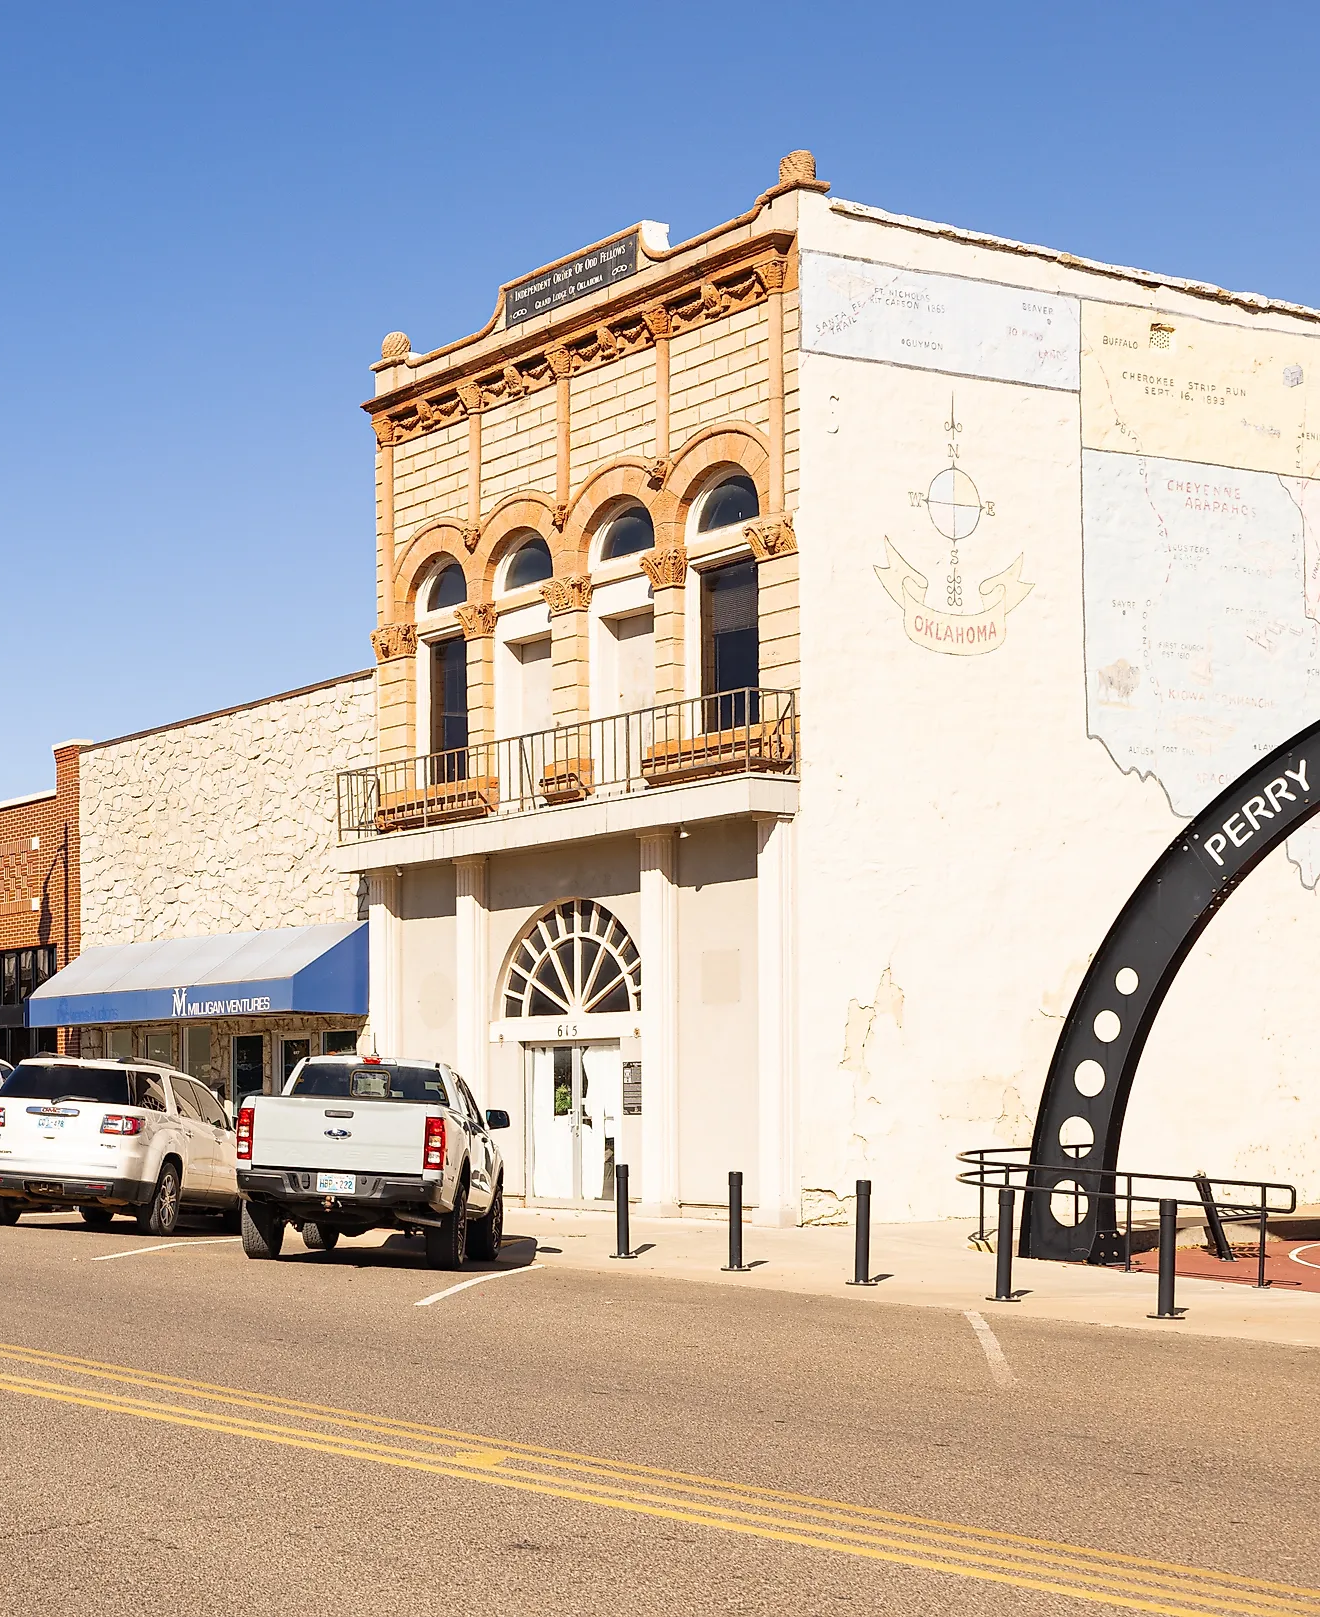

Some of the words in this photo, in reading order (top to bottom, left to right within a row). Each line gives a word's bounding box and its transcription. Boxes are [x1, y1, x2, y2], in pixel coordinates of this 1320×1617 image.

[515, 276, 551, 302] INDEPENDENT
[553, 269, 572, 284] ORDER
[575, 262, 583, 274] OF
[585, 256, 598, 271] ODD
[600, 244, 626, 265] FELLOWS
[535, 295, 552, 310] GRAND
[552, 290, 568, 304] LODGE
[1022, 302, 1054, 315] BEAVER
[906, 339, 944, 351] GUYMON
[1102, 335, 1139, 350] BUFFALO
[1122, 371, 1175, 387] CHEROKEE
[1188, 381, 1217, 393] STRIP
[1225, 387, 1247, 397] RUN
[1202, 396, 1226, 406] 1893
[1306, 432, 1320, 441] ENI
[948, 444, 960, 459] N
[1167, 479, 1242, 500] CHEYENNE
[908, 491, 923, 507] W
[985, 501, 996, 516] E
[950, 549, 959, 564] S
[914, 615, 998, 644] OKLAHOMA
[1203, 759, 1311, 867] PERRY
[188, 1000, 225, 1016] MILLIGAN
[226, 996, 270, 1013] VENTURES
[557, 1024, 578, 1038] 615
